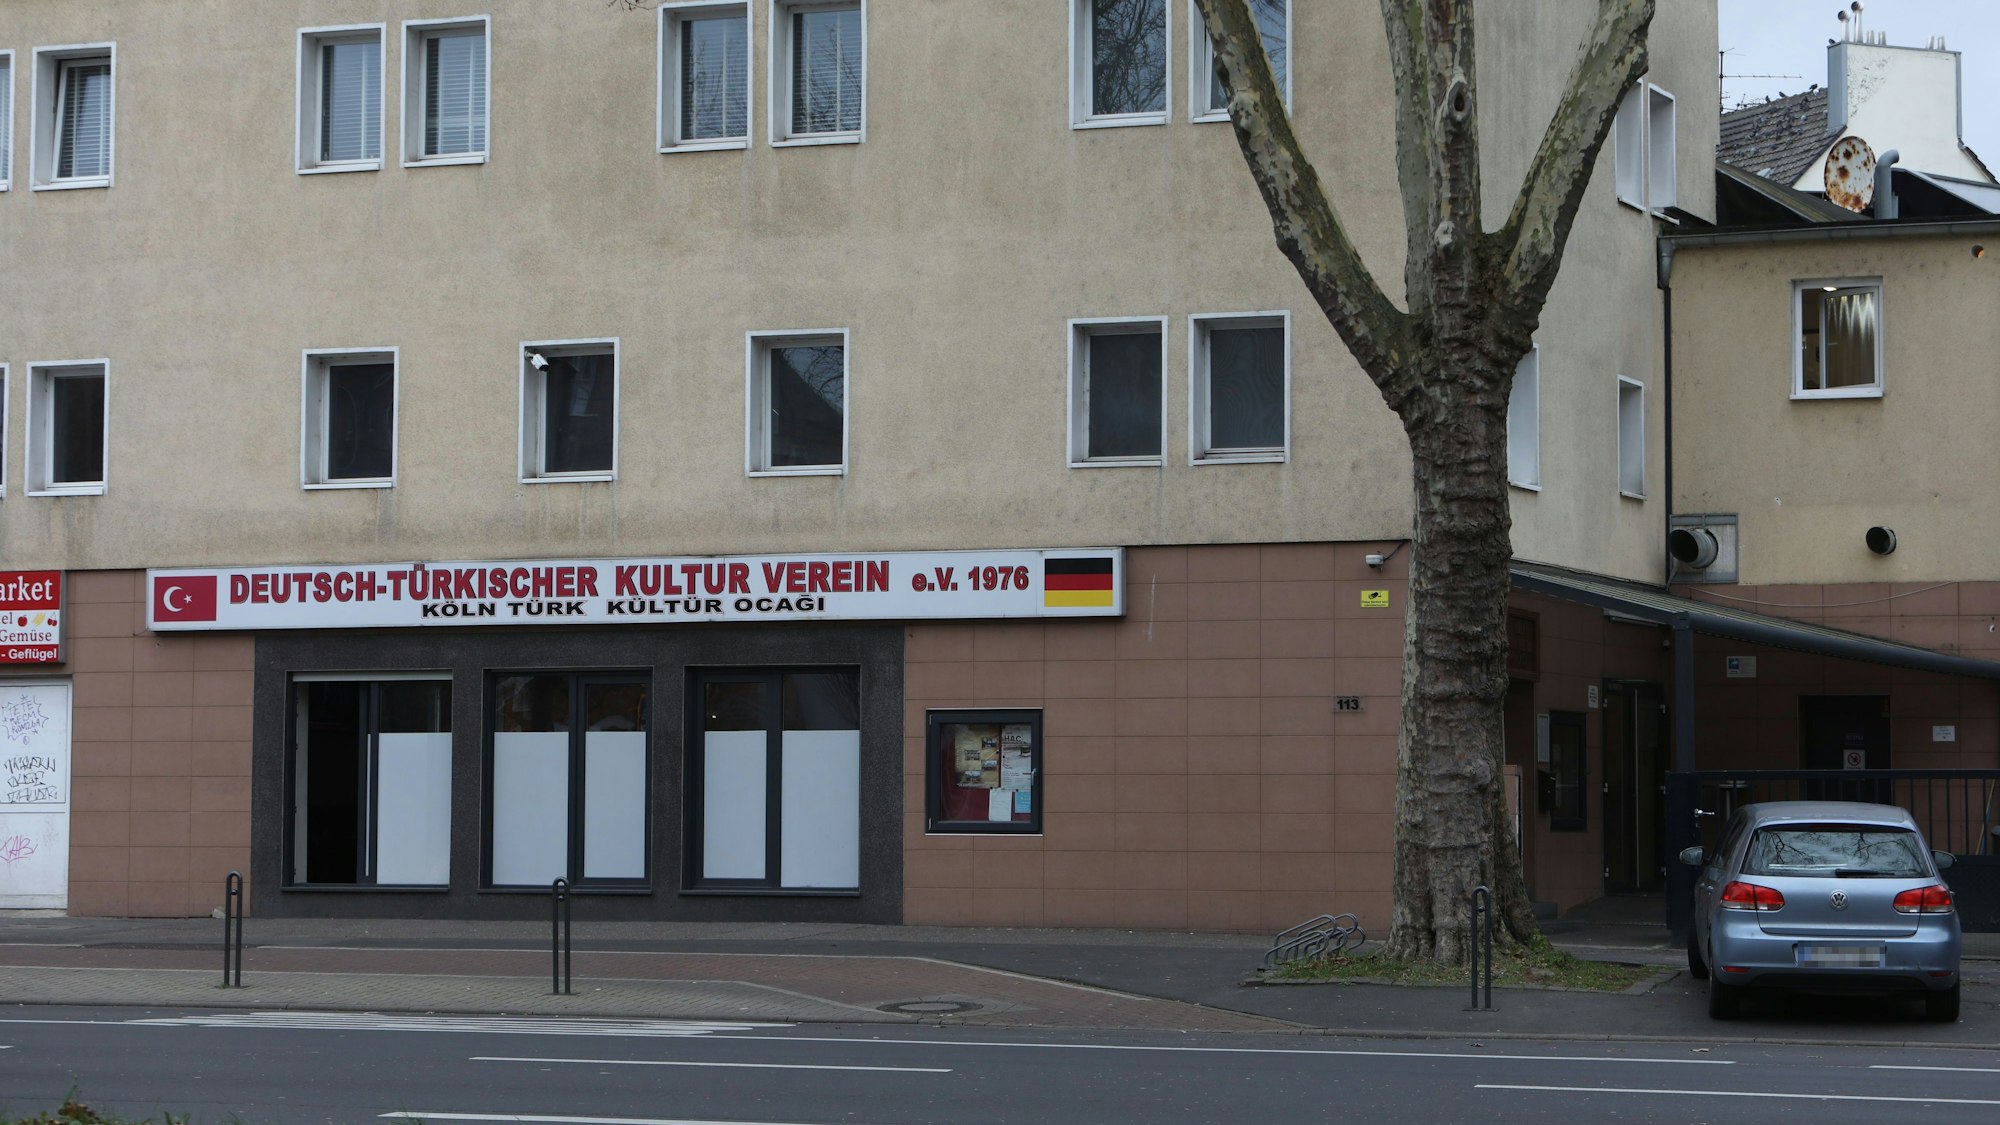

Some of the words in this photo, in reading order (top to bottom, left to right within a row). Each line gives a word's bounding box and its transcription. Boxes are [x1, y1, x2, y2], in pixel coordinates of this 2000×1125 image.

[230, 564, 600, 604] DEUTSCH-TÜRKISCHER
[614, 562, 750, 597] KULTUR
[761, 560, 889, 594] VEREIN
[911, 566, 959, 592] e.V.
[968, 566, 1029, 591] 1976
[422, 599, 497, 619] KÖLN
[510, 598, 586, 617] TÜRK
[606, 595, 722, 616] KÜLTÜR
[735, 593, 825, 613] OCAĞI
[0, 629, 52, 643] Gemüse
[8, 648, 57, 661] Geflügel
[1336, 699, 1359, 710] 113
